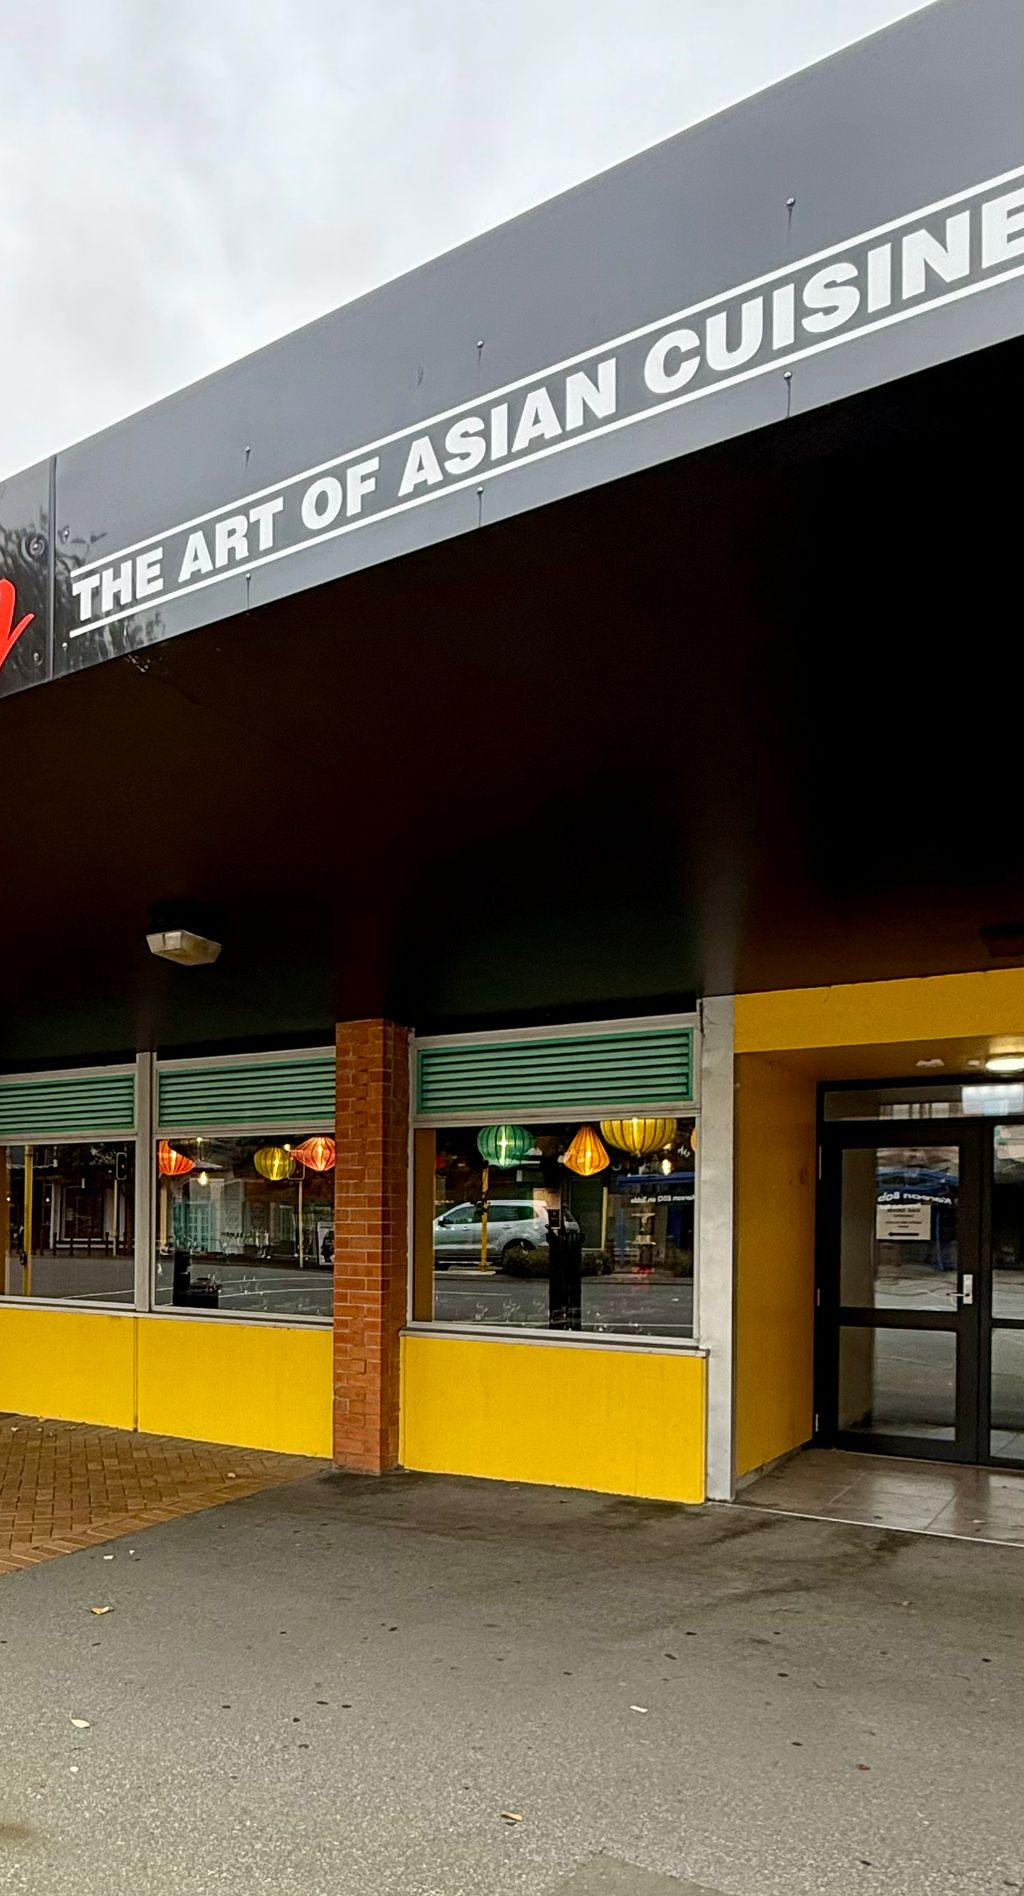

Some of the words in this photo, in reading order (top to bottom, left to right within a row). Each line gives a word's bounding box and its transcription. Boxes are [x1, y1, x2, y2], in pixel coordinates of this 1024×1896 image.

[72, 547, 164, 622] THE
[177, 498, 284, 584] ART
[301, 456, 380, 531] OF
[397, 357, 617, 498] ASIAN
[643, 186, 1024, 395] CUISINE
